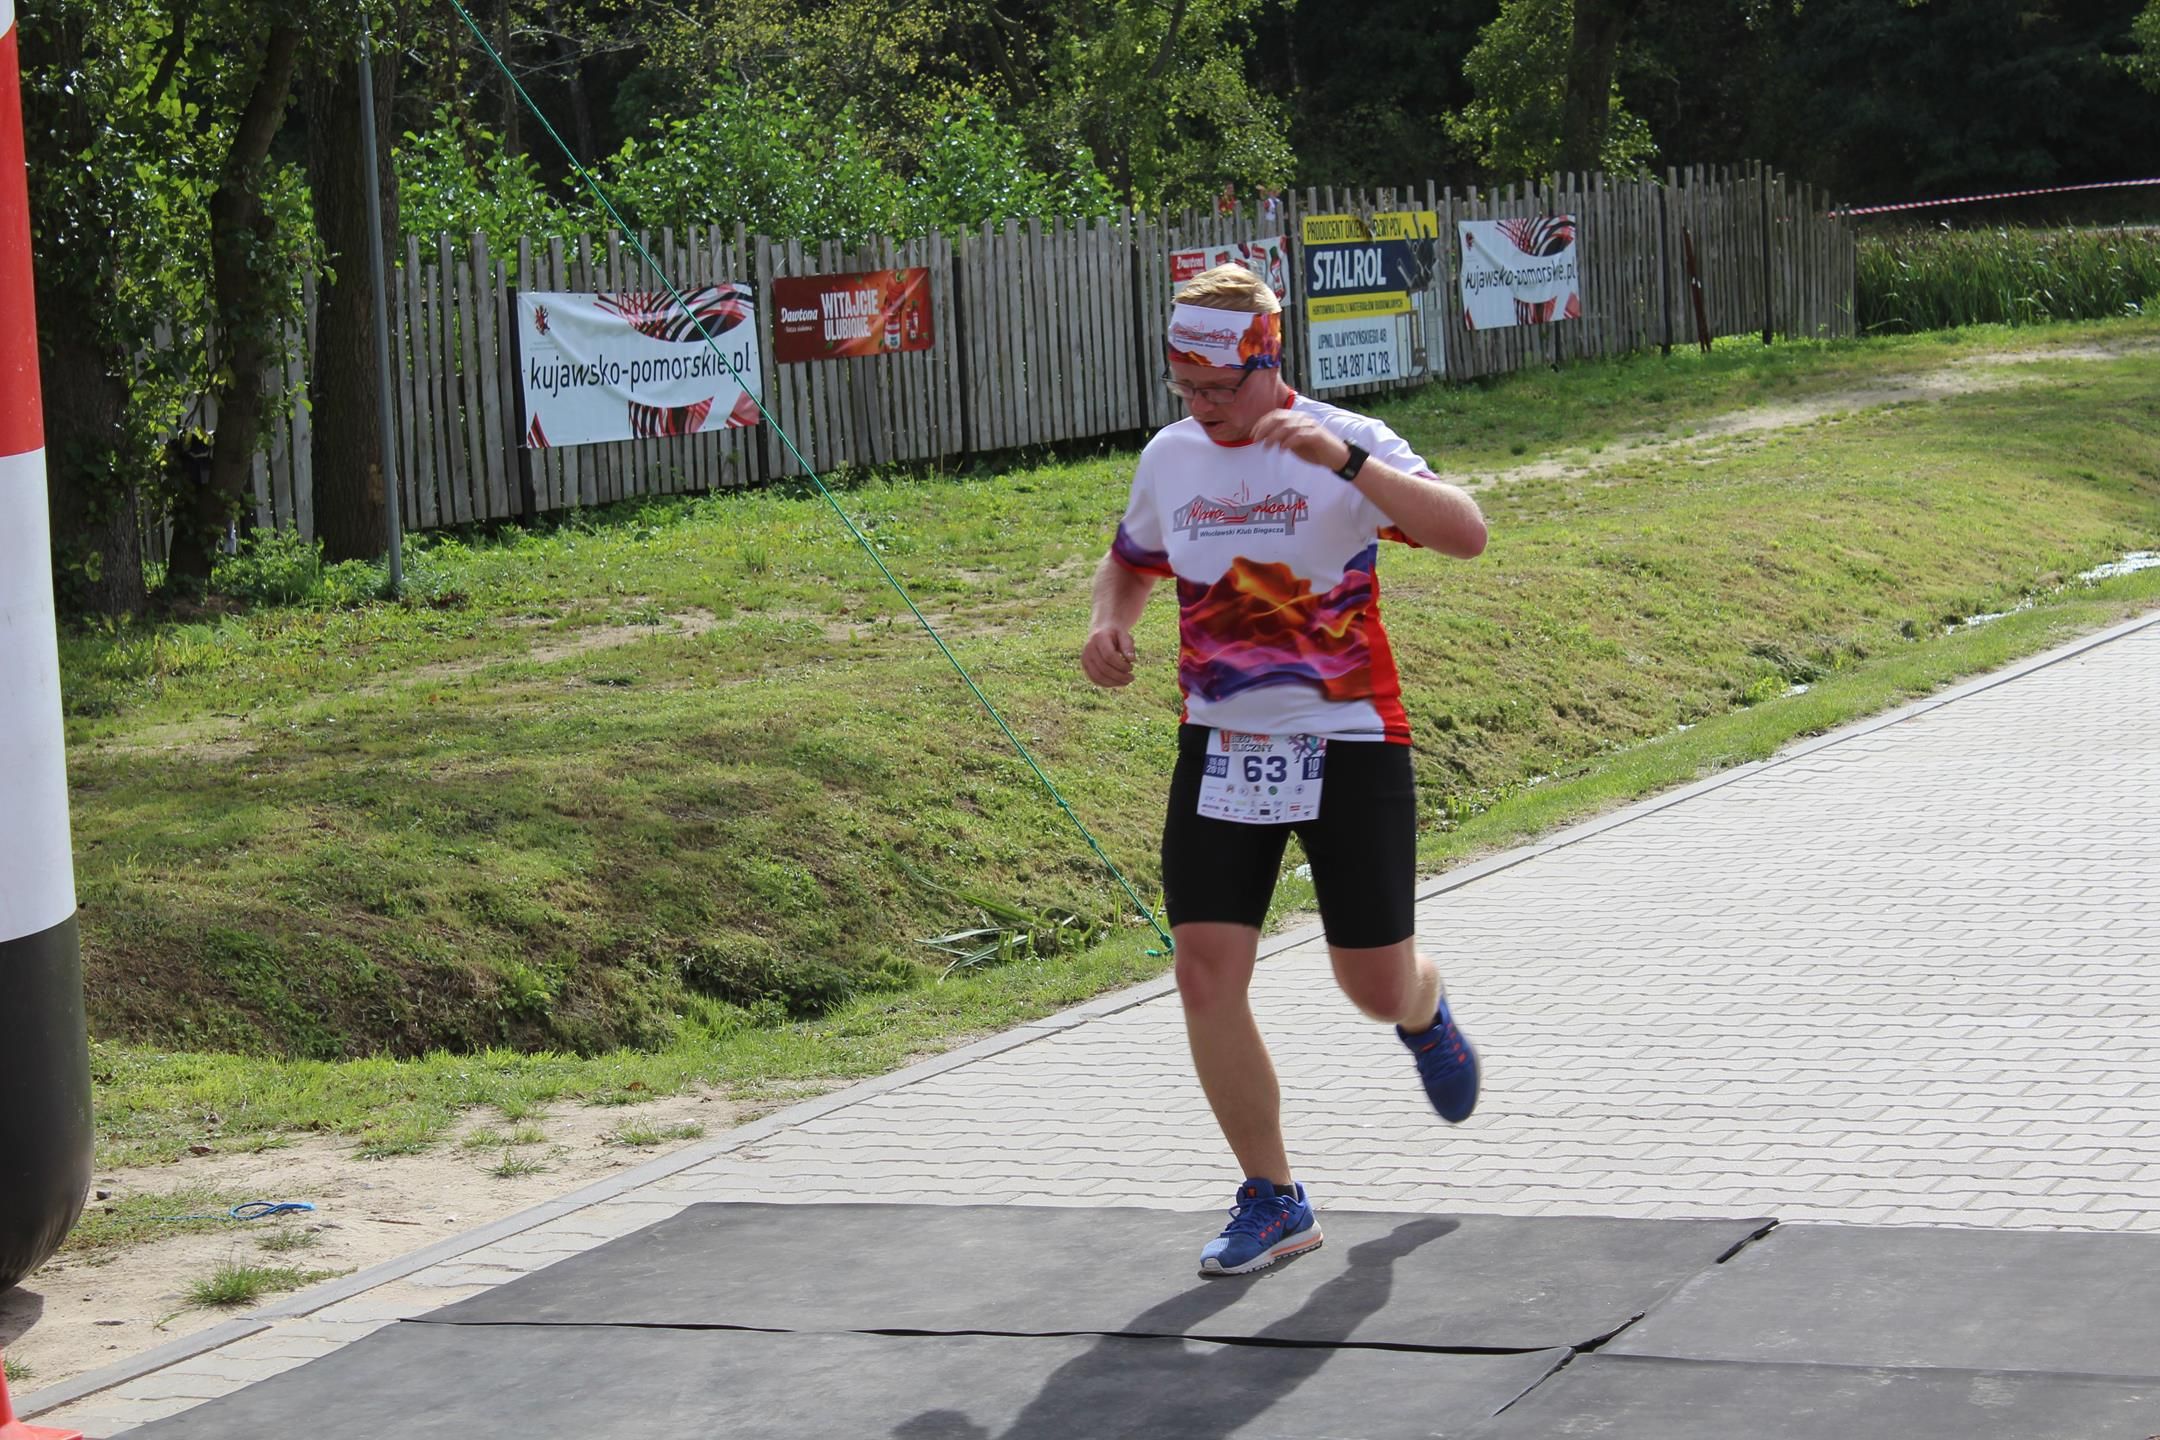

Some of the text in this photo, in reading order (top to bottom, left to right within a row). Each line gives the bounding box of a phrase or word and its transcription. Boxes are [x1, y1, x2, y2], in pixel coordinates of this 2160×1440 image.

[1306, 219, 1344, 240] PRODUCENT
[1312, 248, 1387, 291] STALROL
[780, 307, 819, 324] Dawtona
[820, 289, 880, 319] WITAJCIE
[824, 316, 872, 341] ULUBIONE
[530, 342, 751, 398] kujawsko-pomorskie.pl
[1318, 351, 1390, 381] TEL. 54 287 47 28
[1253, 527, 1284, 535] Biegacza
[1231, 744, 1273, 752] ULICZNY
[1243, 755, 1287, 783] 63
[1308, 758, 1320, 771] 10
